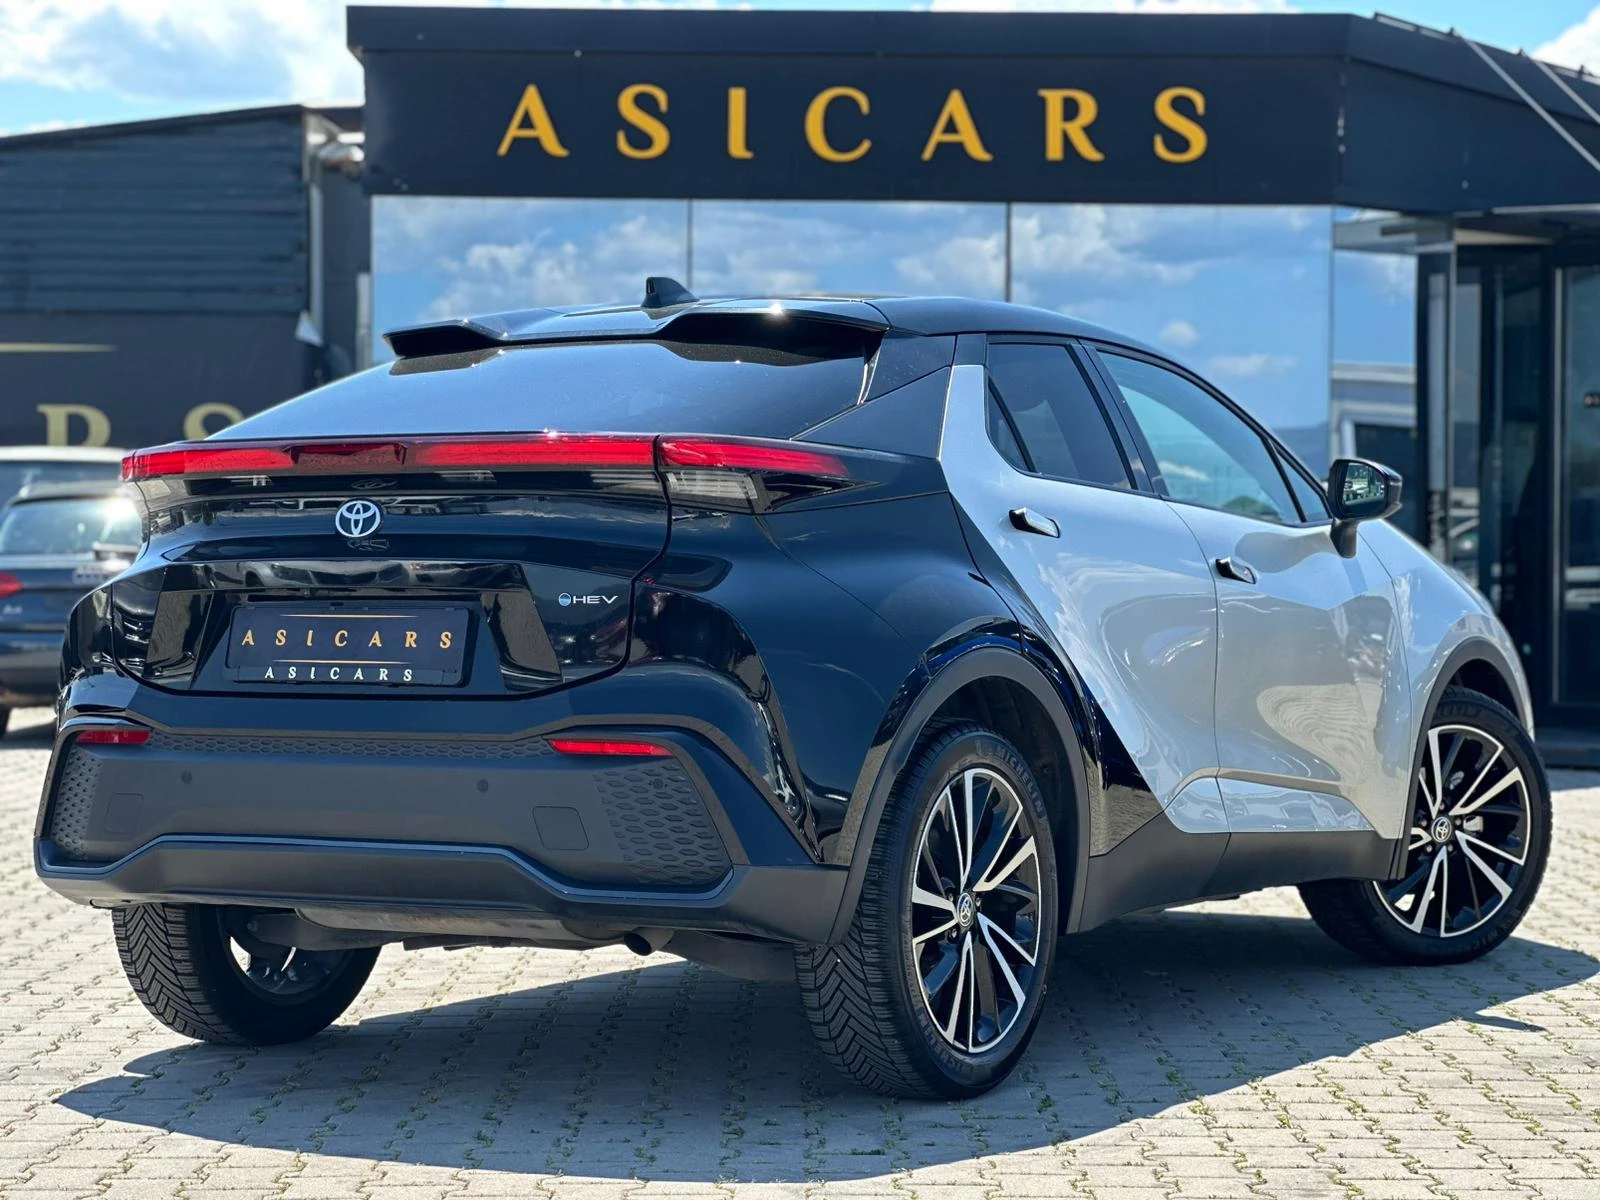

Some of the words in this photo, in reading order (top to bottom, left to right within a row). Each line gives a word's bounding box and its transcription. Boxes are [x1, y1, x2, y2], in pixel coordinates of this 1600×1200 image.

[497, 84, 1209, 163] ASICARS
[572, 595, 619, 604] HEV
[241, 629, 452, 649] ASICARS
[264, 666, 413, 682] ASICARS
